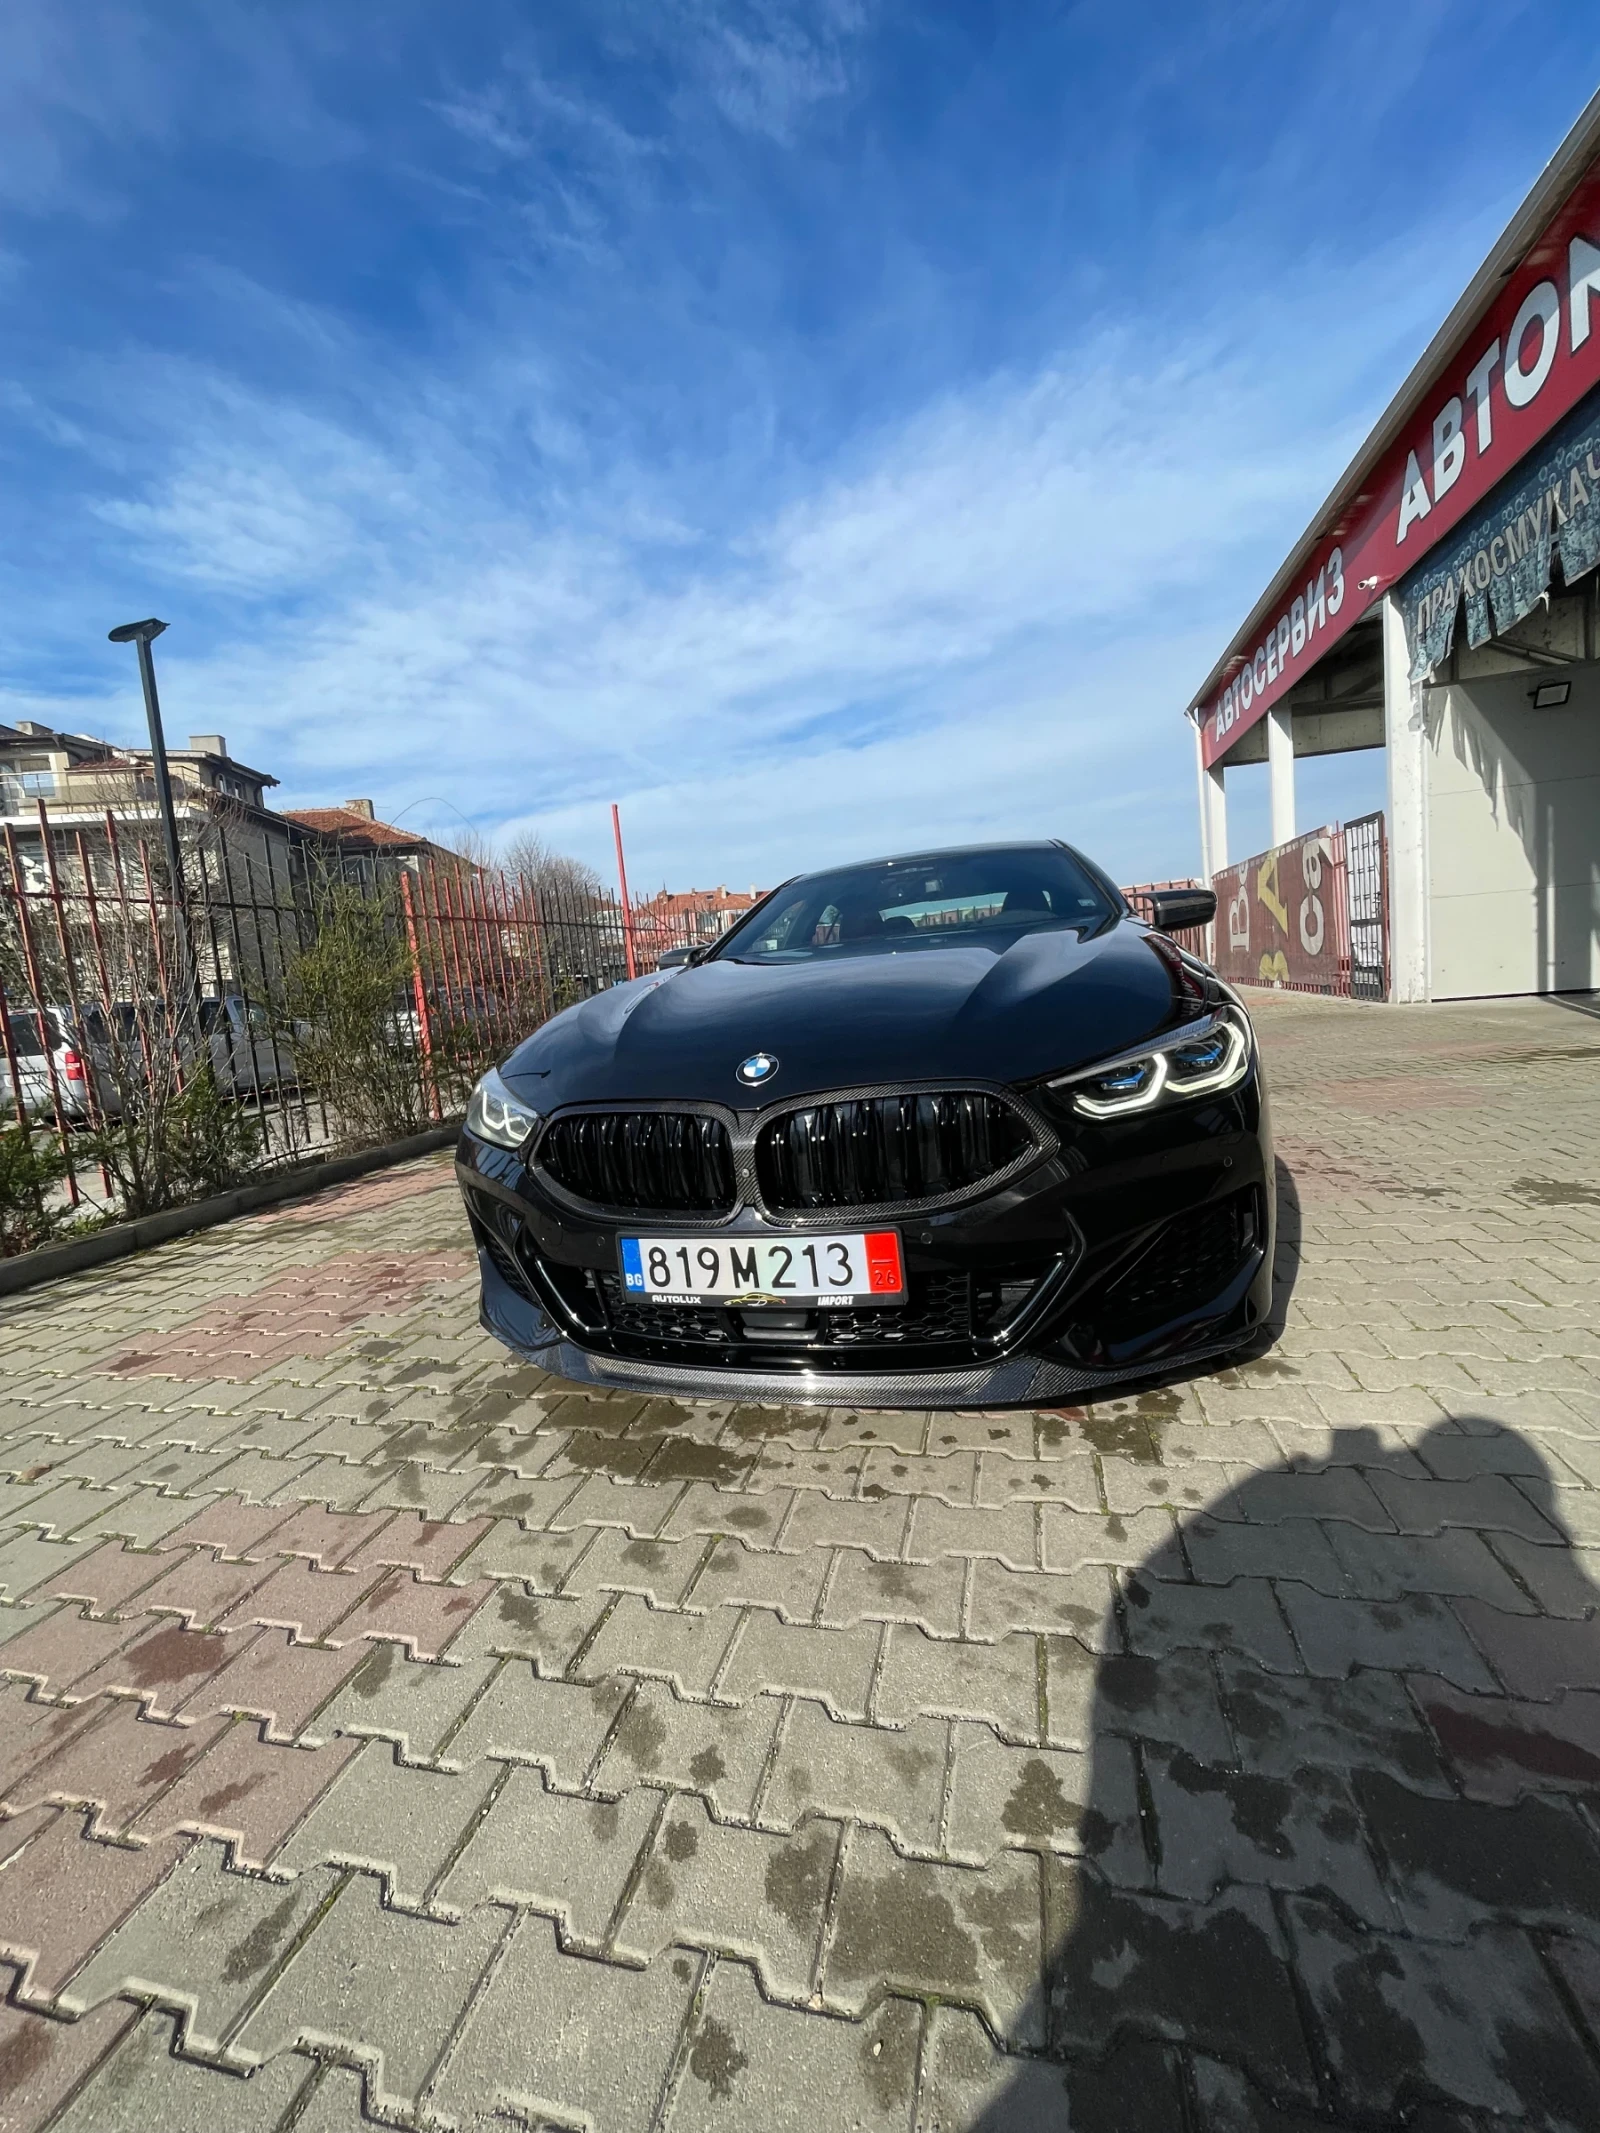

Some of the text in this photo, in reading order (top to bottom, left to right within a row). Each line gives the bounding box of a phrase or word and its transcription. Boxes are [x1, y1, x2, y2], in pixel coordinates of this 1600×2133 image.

[1215, 546, 1345, 742] АВТОСЕРВИЗ
[648, 1243, 853, 1288] 819M213
[625, 1273, 643, 1286] BG
[874, 1270, 896, 1286] 26
[652, 1294, 854, 1306] AUTOLUX IMPORT
